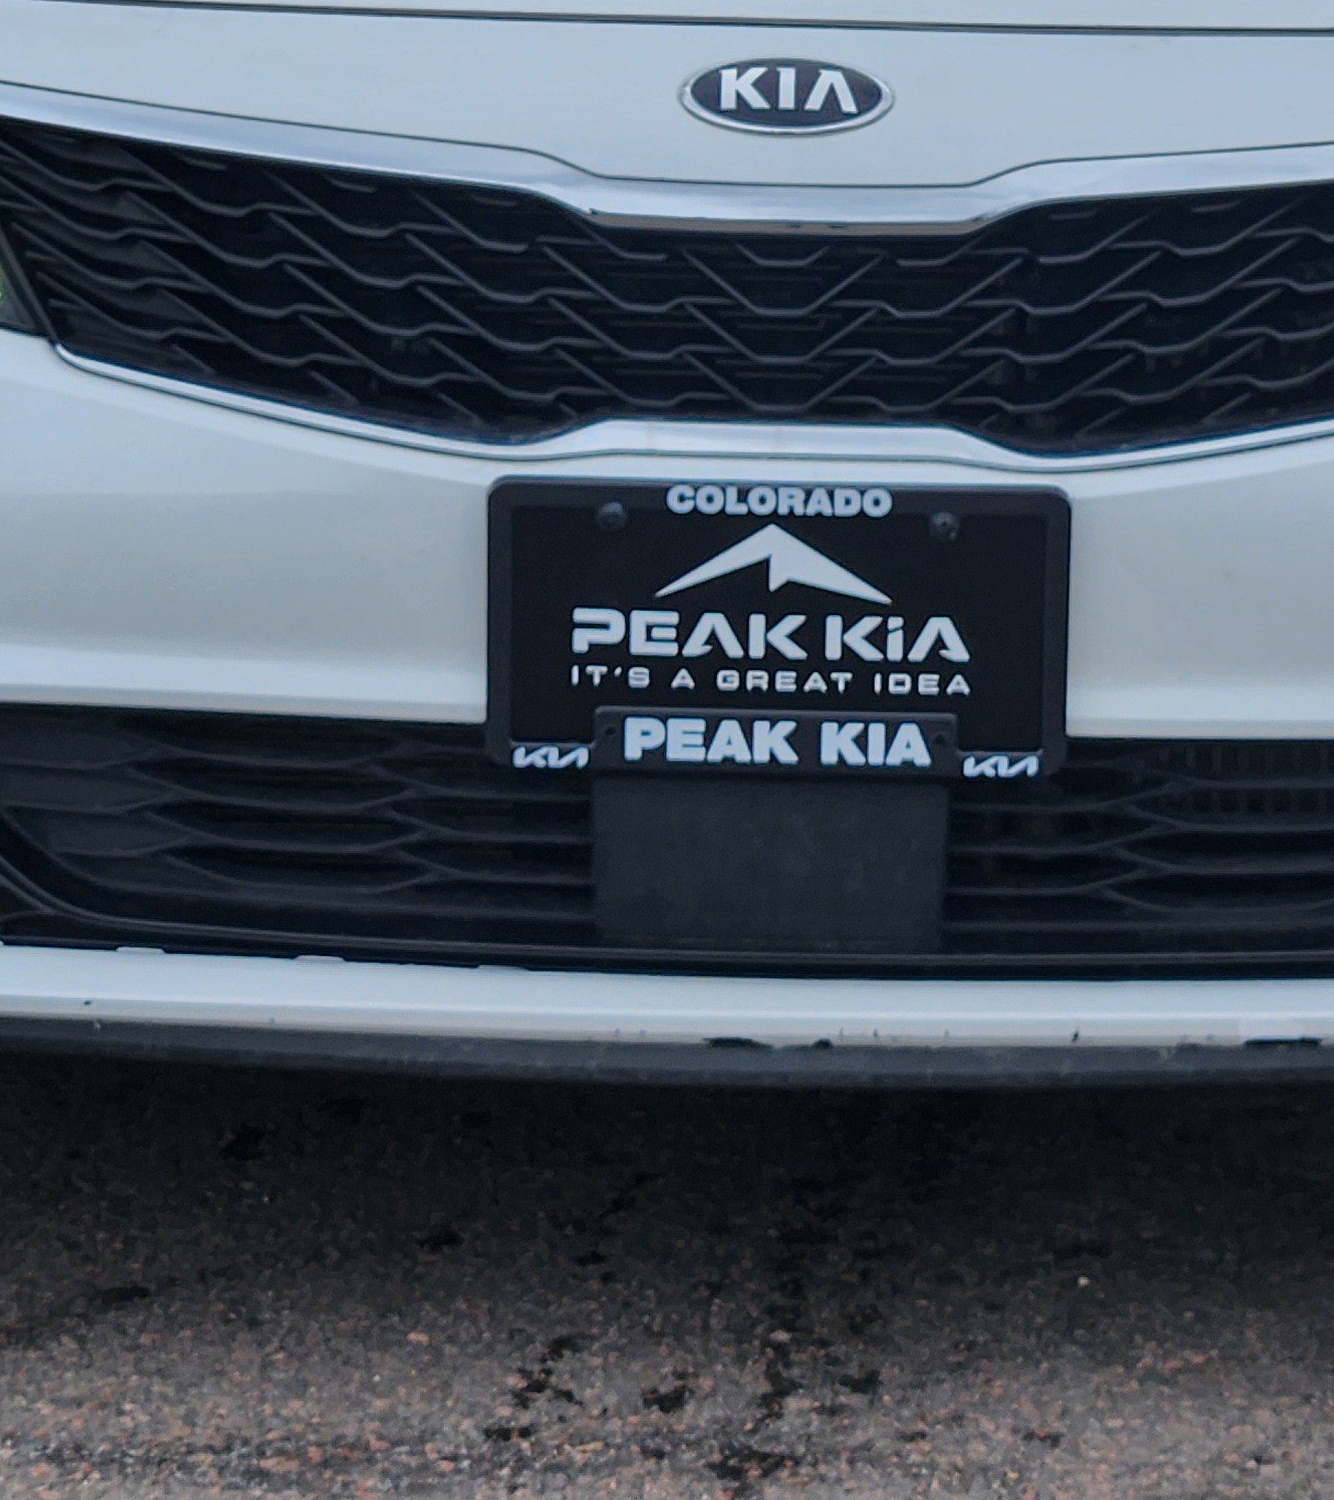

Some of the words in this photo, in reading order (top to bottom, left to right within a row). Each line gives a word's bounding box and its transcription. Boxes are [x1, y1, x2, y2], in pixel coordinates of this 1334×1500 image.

[720, 66, 859, 115] KIA
[667, 485, 893, 517] COLORADO
[572, 607, 808, 659] PEAK
[571, 665, 650, 688] IT'S
[671, 668, 695, 690] A
[716, 670, 853, 693] GREAT
[874, 673, 970, 696] IDEA
[623, 716, 799, 765] PEAK
[820, 721, 932, 767] KIA
